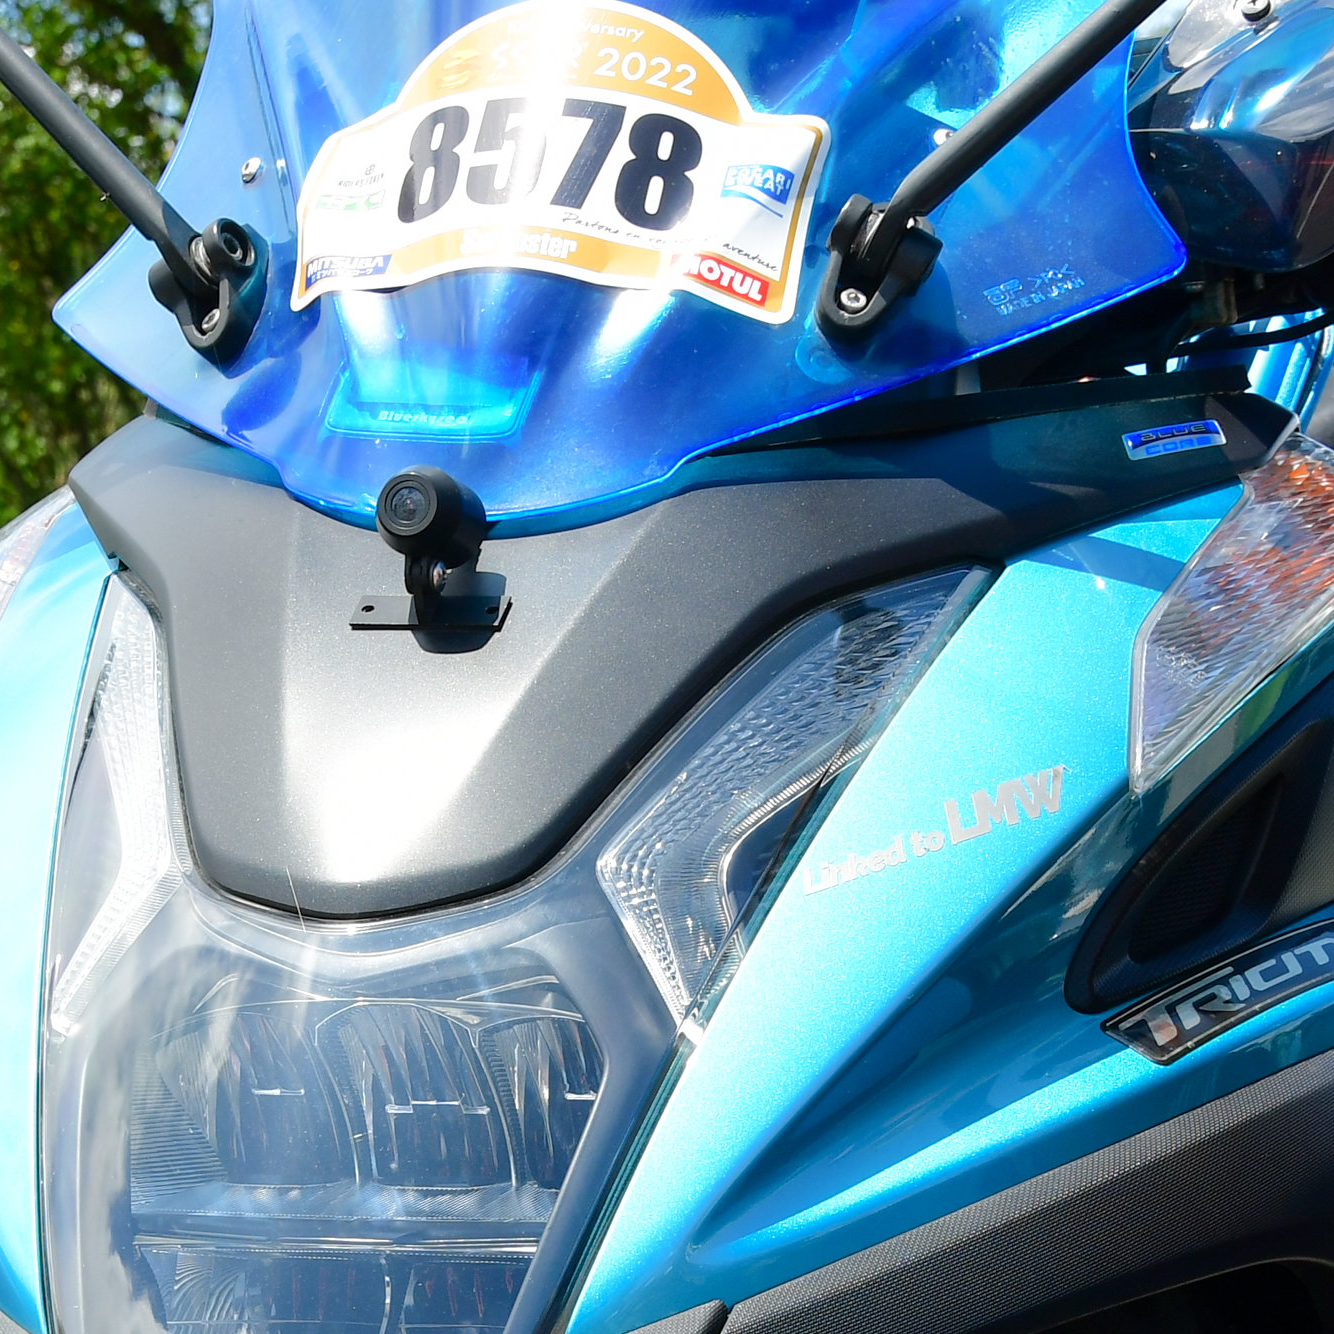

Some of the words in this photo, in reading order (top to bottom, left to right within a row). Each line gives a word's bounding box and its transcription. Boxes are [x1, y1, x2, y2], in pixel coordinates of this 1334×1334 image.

[592, 46, 698, 97] 2022
[397, 97, 703, 232] 8578
[1140, 423, 1207, 442] BLUE
[1145, 436, 1212, 456] CORE
[802, 836, 908, 897] Linked
[910, 829, 945, 858] to
[944, 765, 1065, 845] LMW
